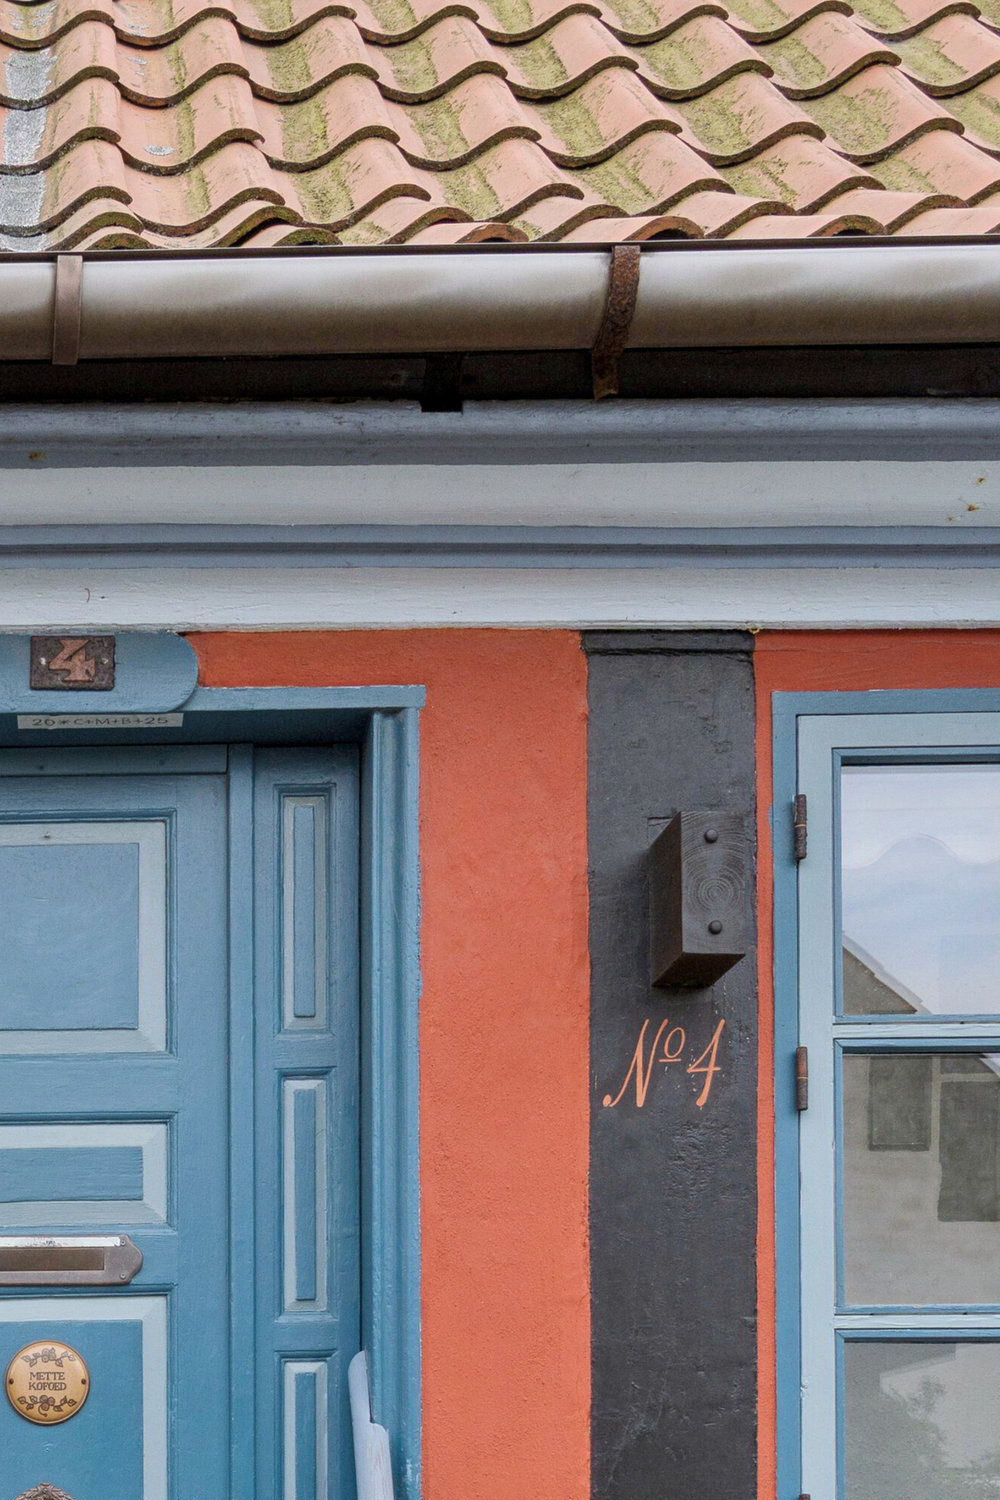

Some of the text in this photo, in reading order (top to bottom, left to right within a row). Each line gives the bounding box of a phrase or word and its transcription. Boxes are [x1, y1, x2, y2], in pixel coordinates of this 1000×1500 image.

[48, 639, 96, 682] 4
[686, 1018, 726, 1107] 4
[28, 1381, 67, 1391] KOFOED
[29, 1371, 66, 1380] METTE
